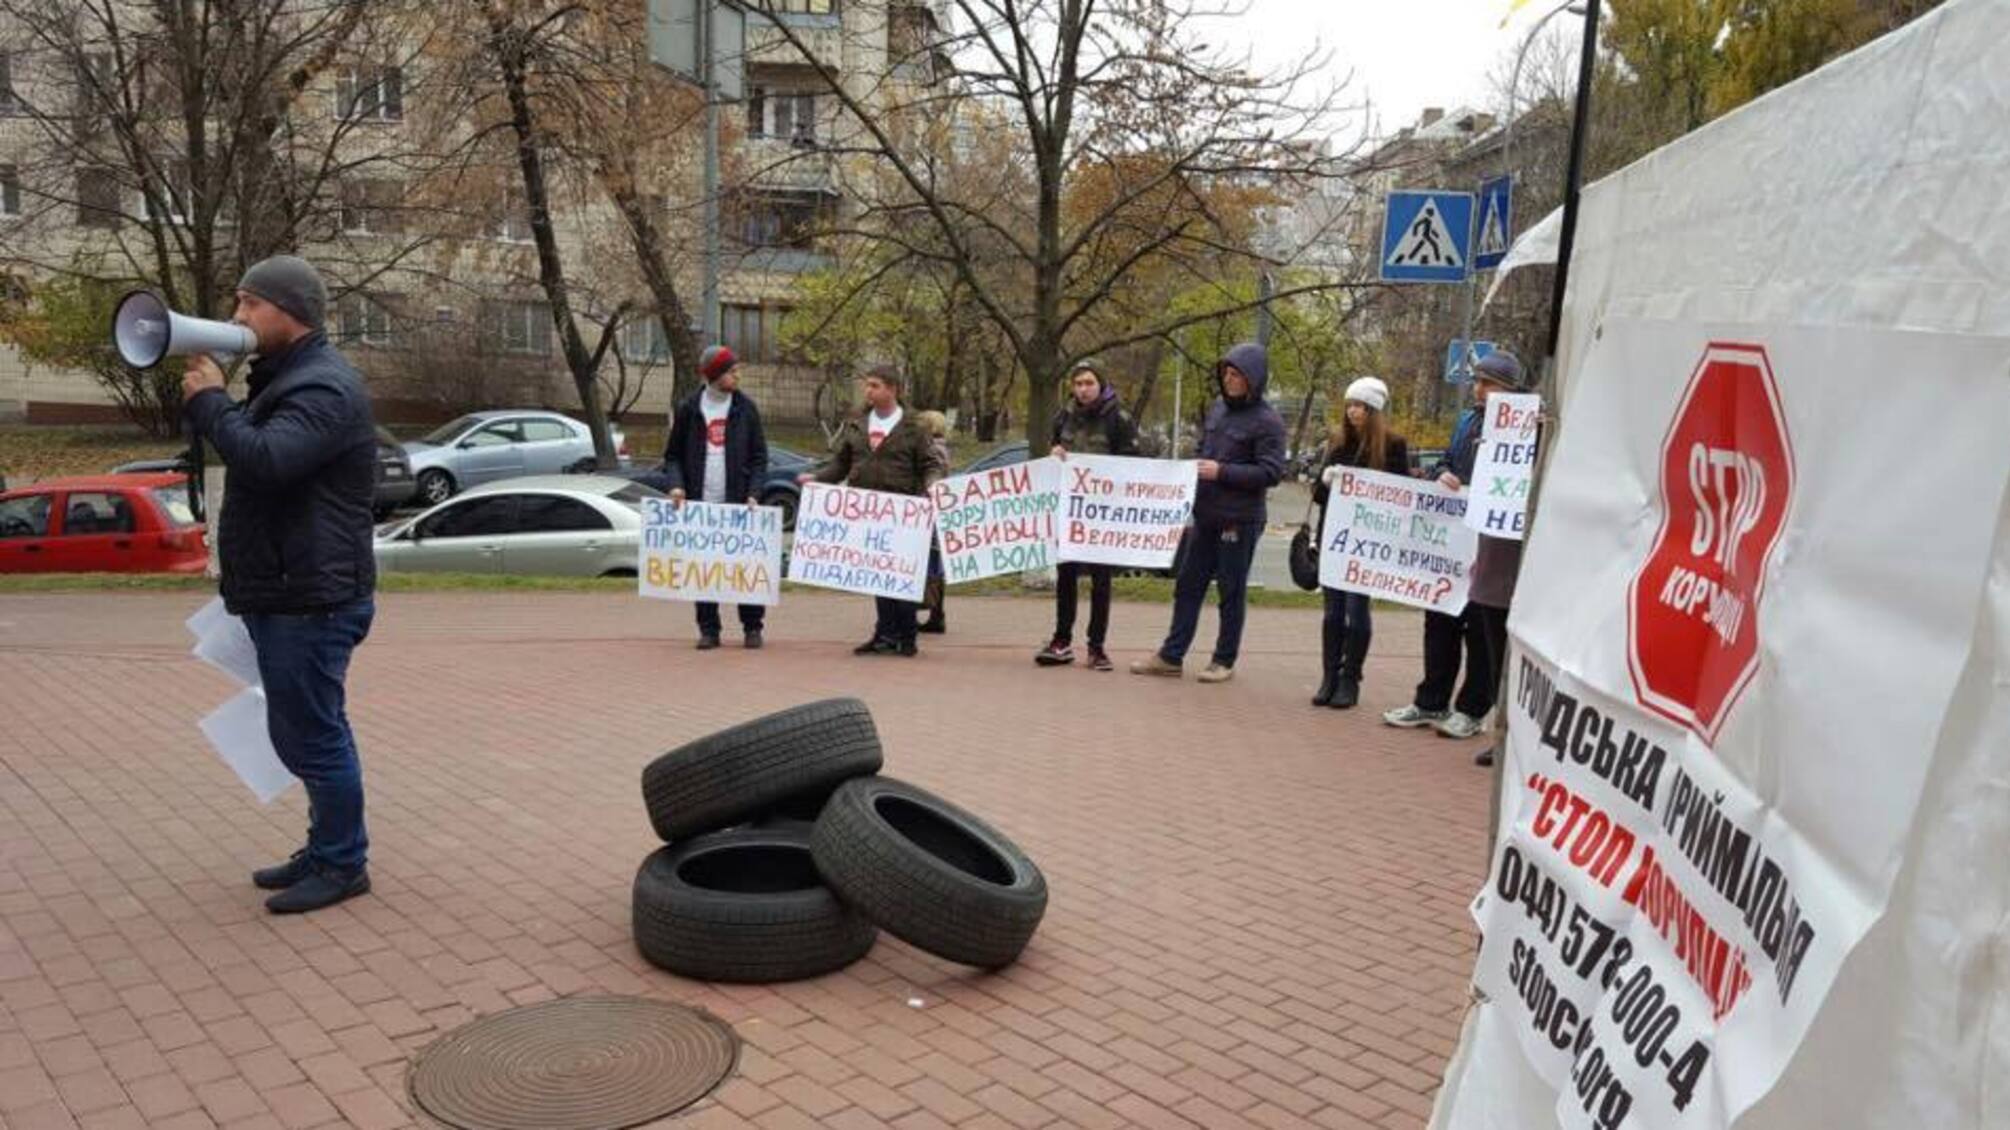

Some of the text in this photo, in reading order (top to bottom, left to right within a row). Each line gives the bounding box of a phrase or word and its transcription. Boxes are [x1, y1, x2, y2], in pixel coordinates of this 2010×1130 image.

[936, 464, 1032, 511] ВАДИ
[1416, 492, 1468, 517] кришу
[940, 491, 1059, 531] ЗОРУ ПРОКУРО
[645, 528, 769, 556] ПРОКУРОРА
[800, 518, 894, 553] ЧОМУ НЕ
[1328, 528, 1350, 553] А
[646, 556, 771, 595] ВЕЛИЧКА
[951, 553, 979, 579] НА
[1517, 654, 1668, 813] ГРОМДСЬКА
